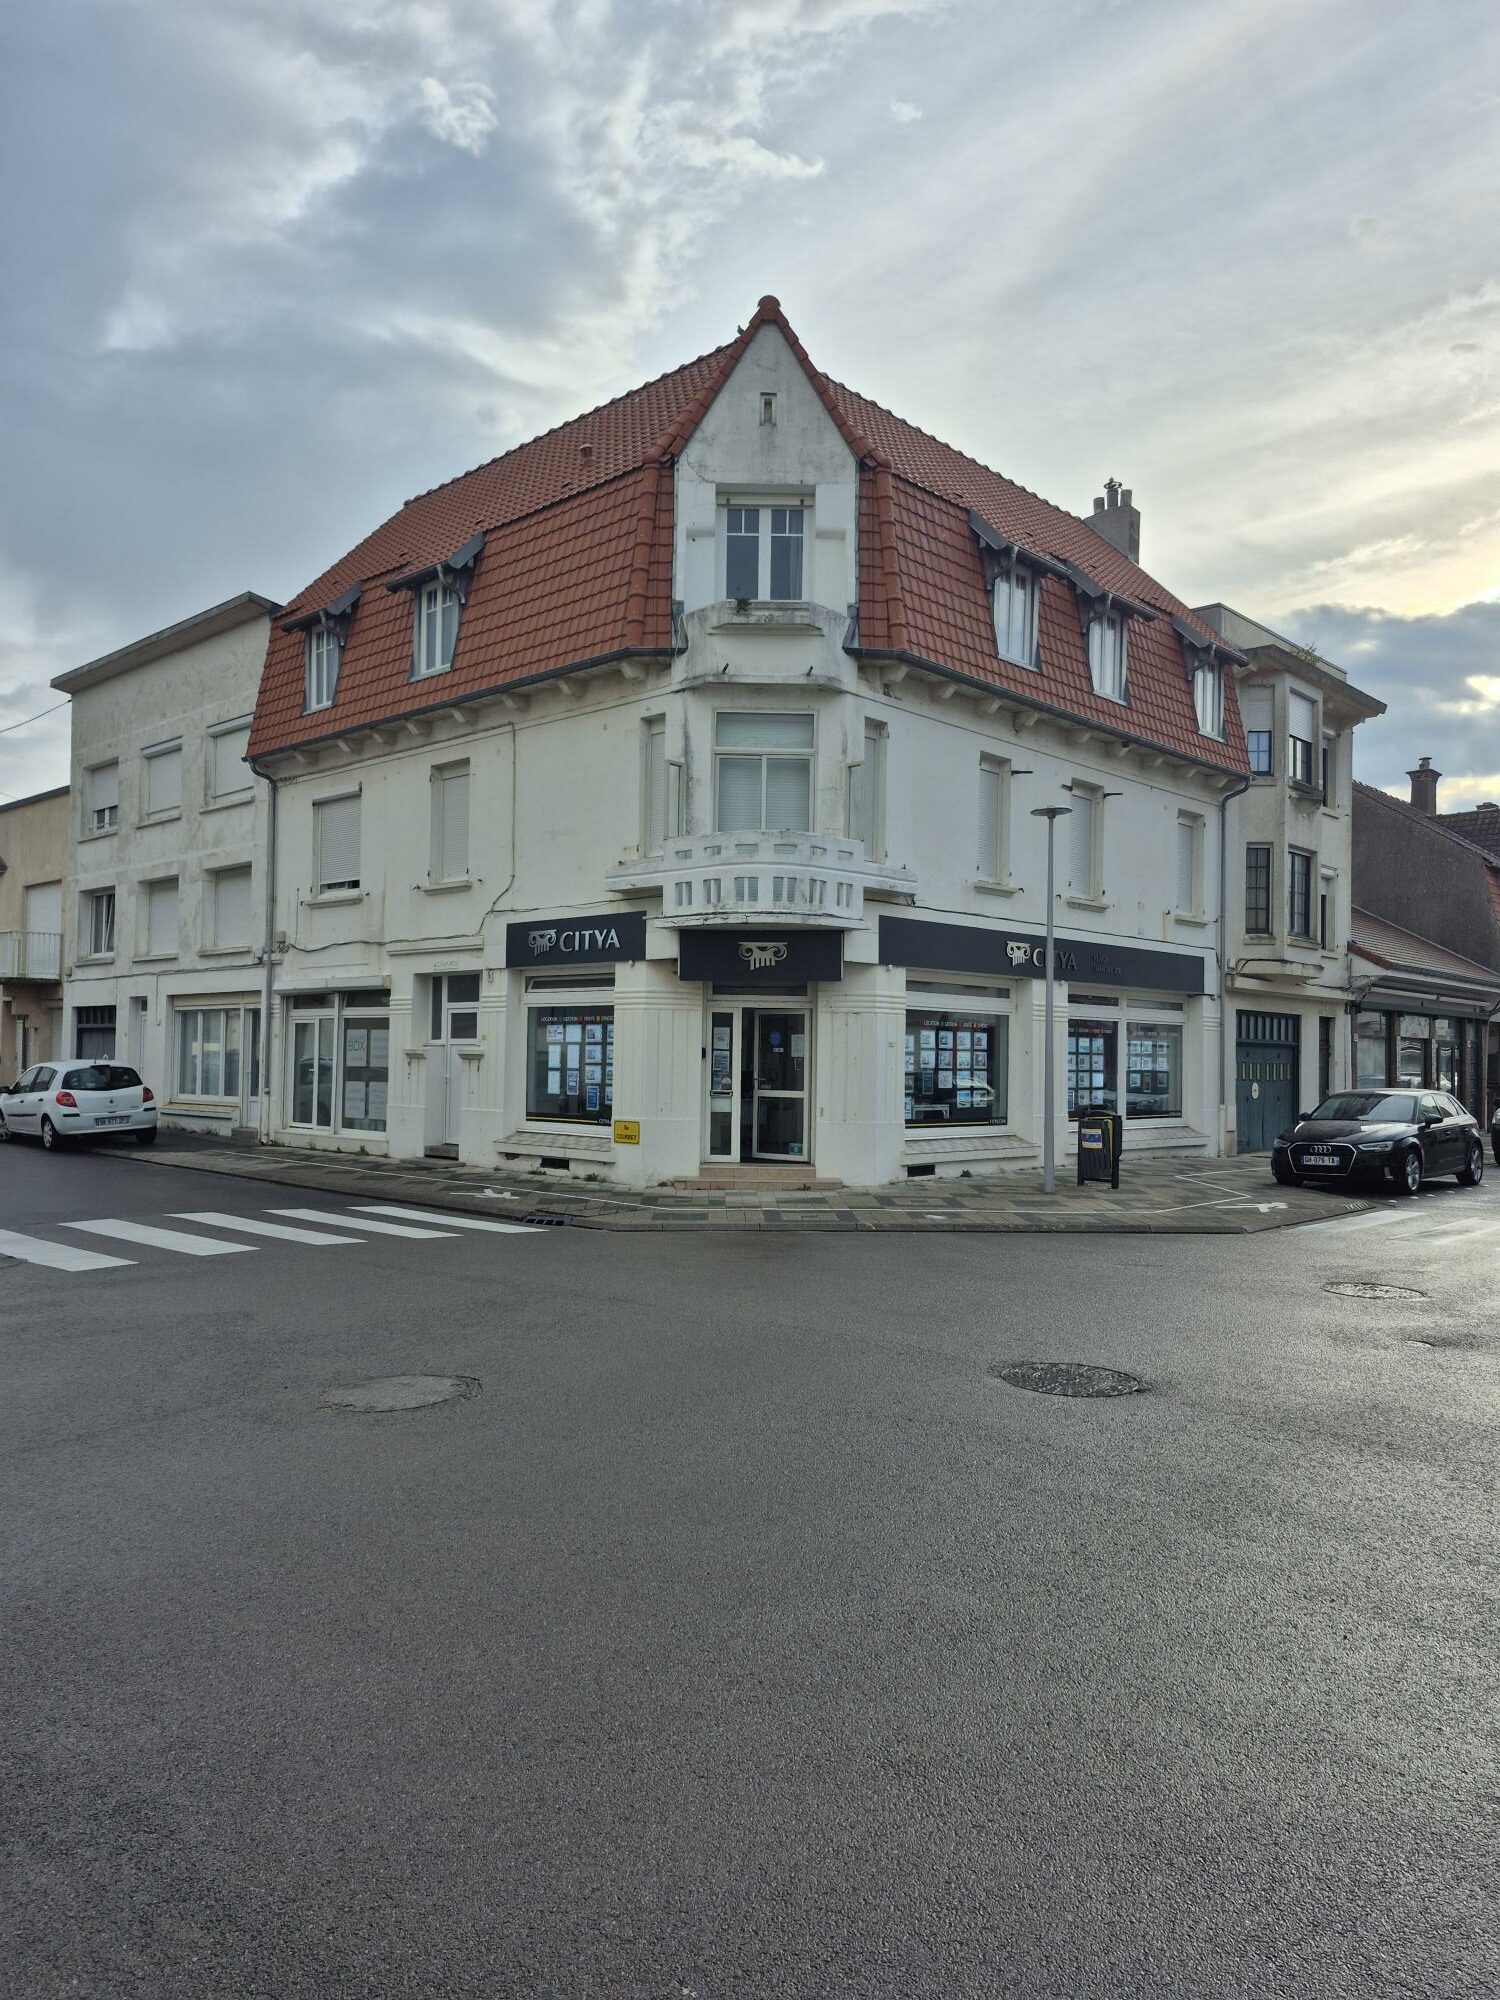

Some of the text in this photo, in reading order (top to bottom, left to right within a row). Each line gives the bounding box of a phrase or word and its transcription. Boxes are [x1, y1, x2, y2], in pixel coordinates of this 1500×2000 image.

[559, 928, 621, 952] CITYA
[1032, 948, 1078, 971] CYA
[348, 1040, 365, 1052] BOX
